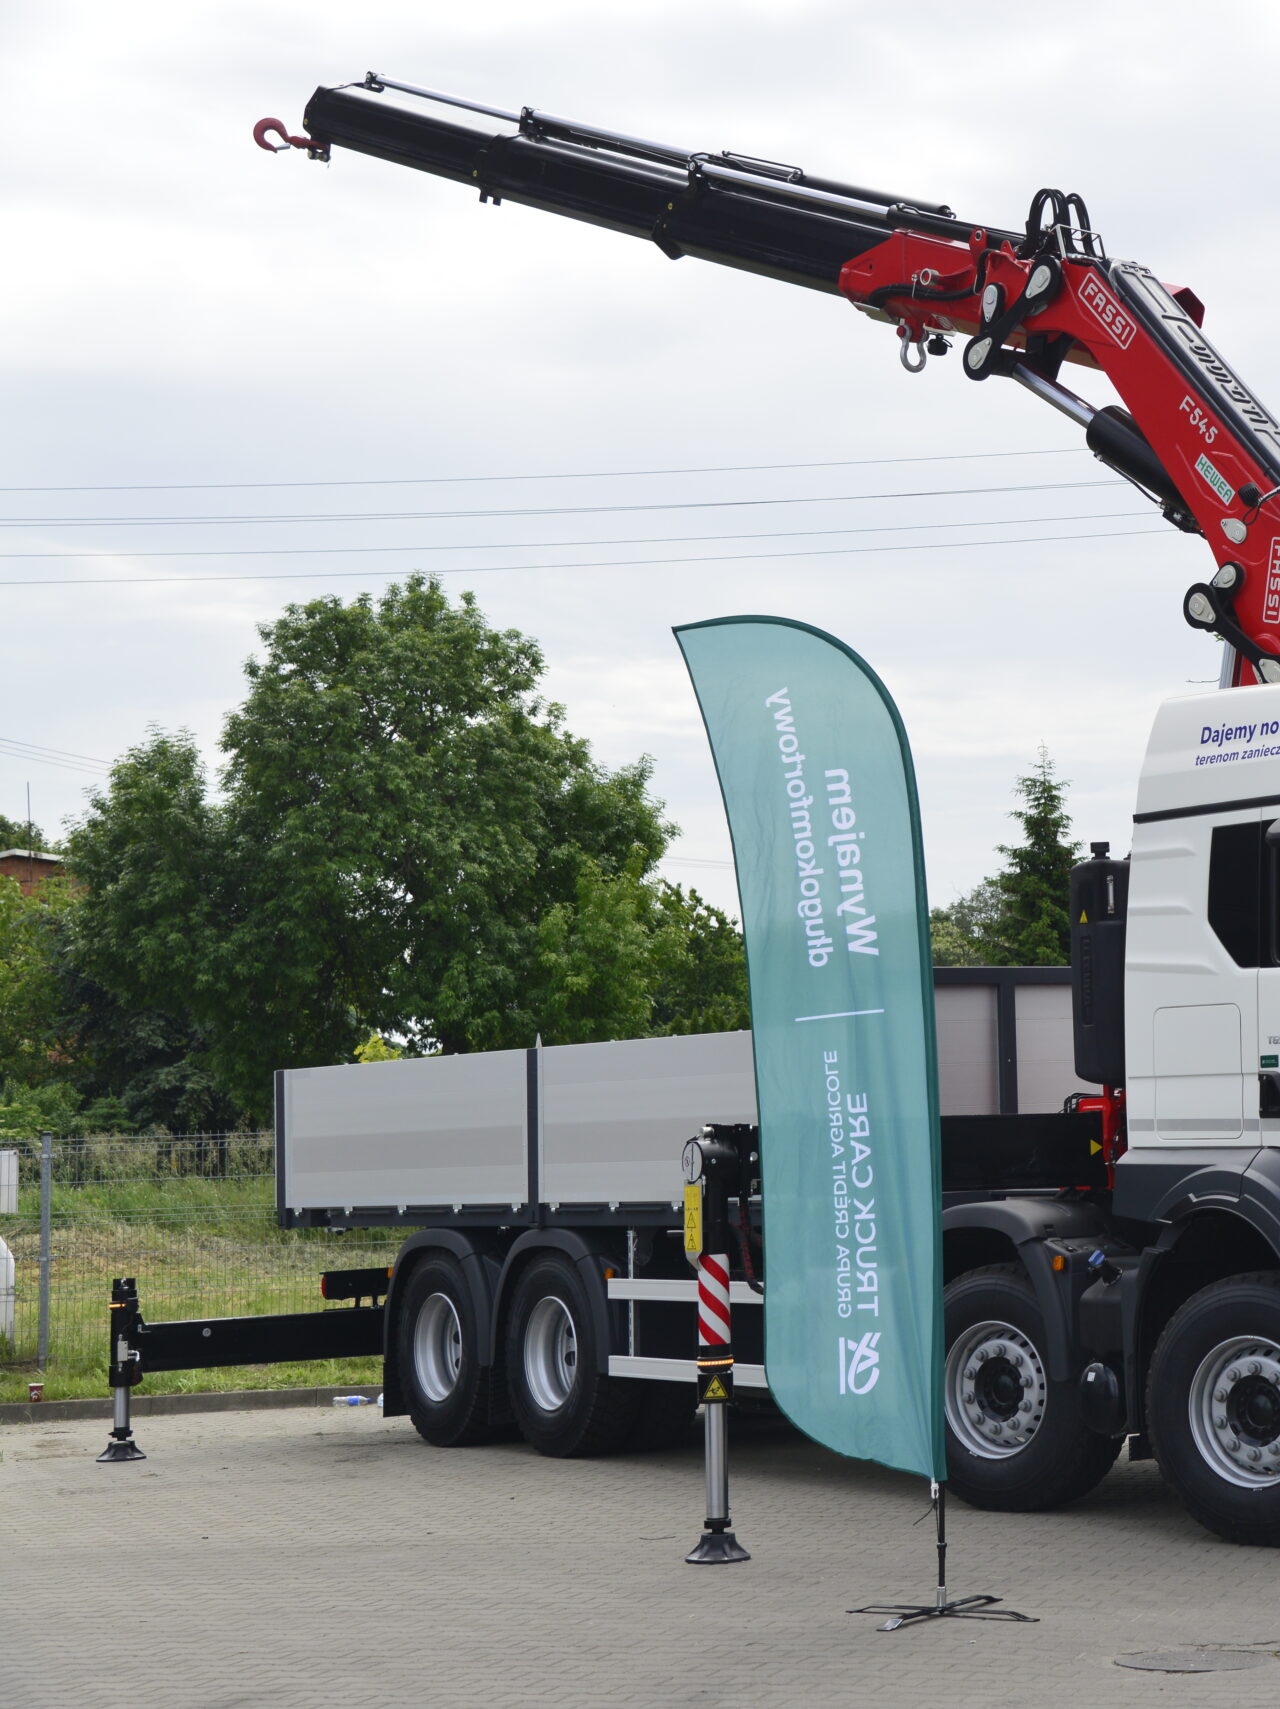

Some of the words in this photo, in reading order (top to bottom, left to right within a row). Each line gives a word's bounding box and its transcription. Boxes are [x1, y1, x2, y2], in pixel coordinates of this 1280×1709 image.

[1085, 282, 1131, 341] FASSI
[1179, 395, 1219, 444] F545
[1196, 455, 1233, 503] HEWEA
[1195, 751, 1239, 766] terenom
[1200, 723, 1257, 748] Dajemy
